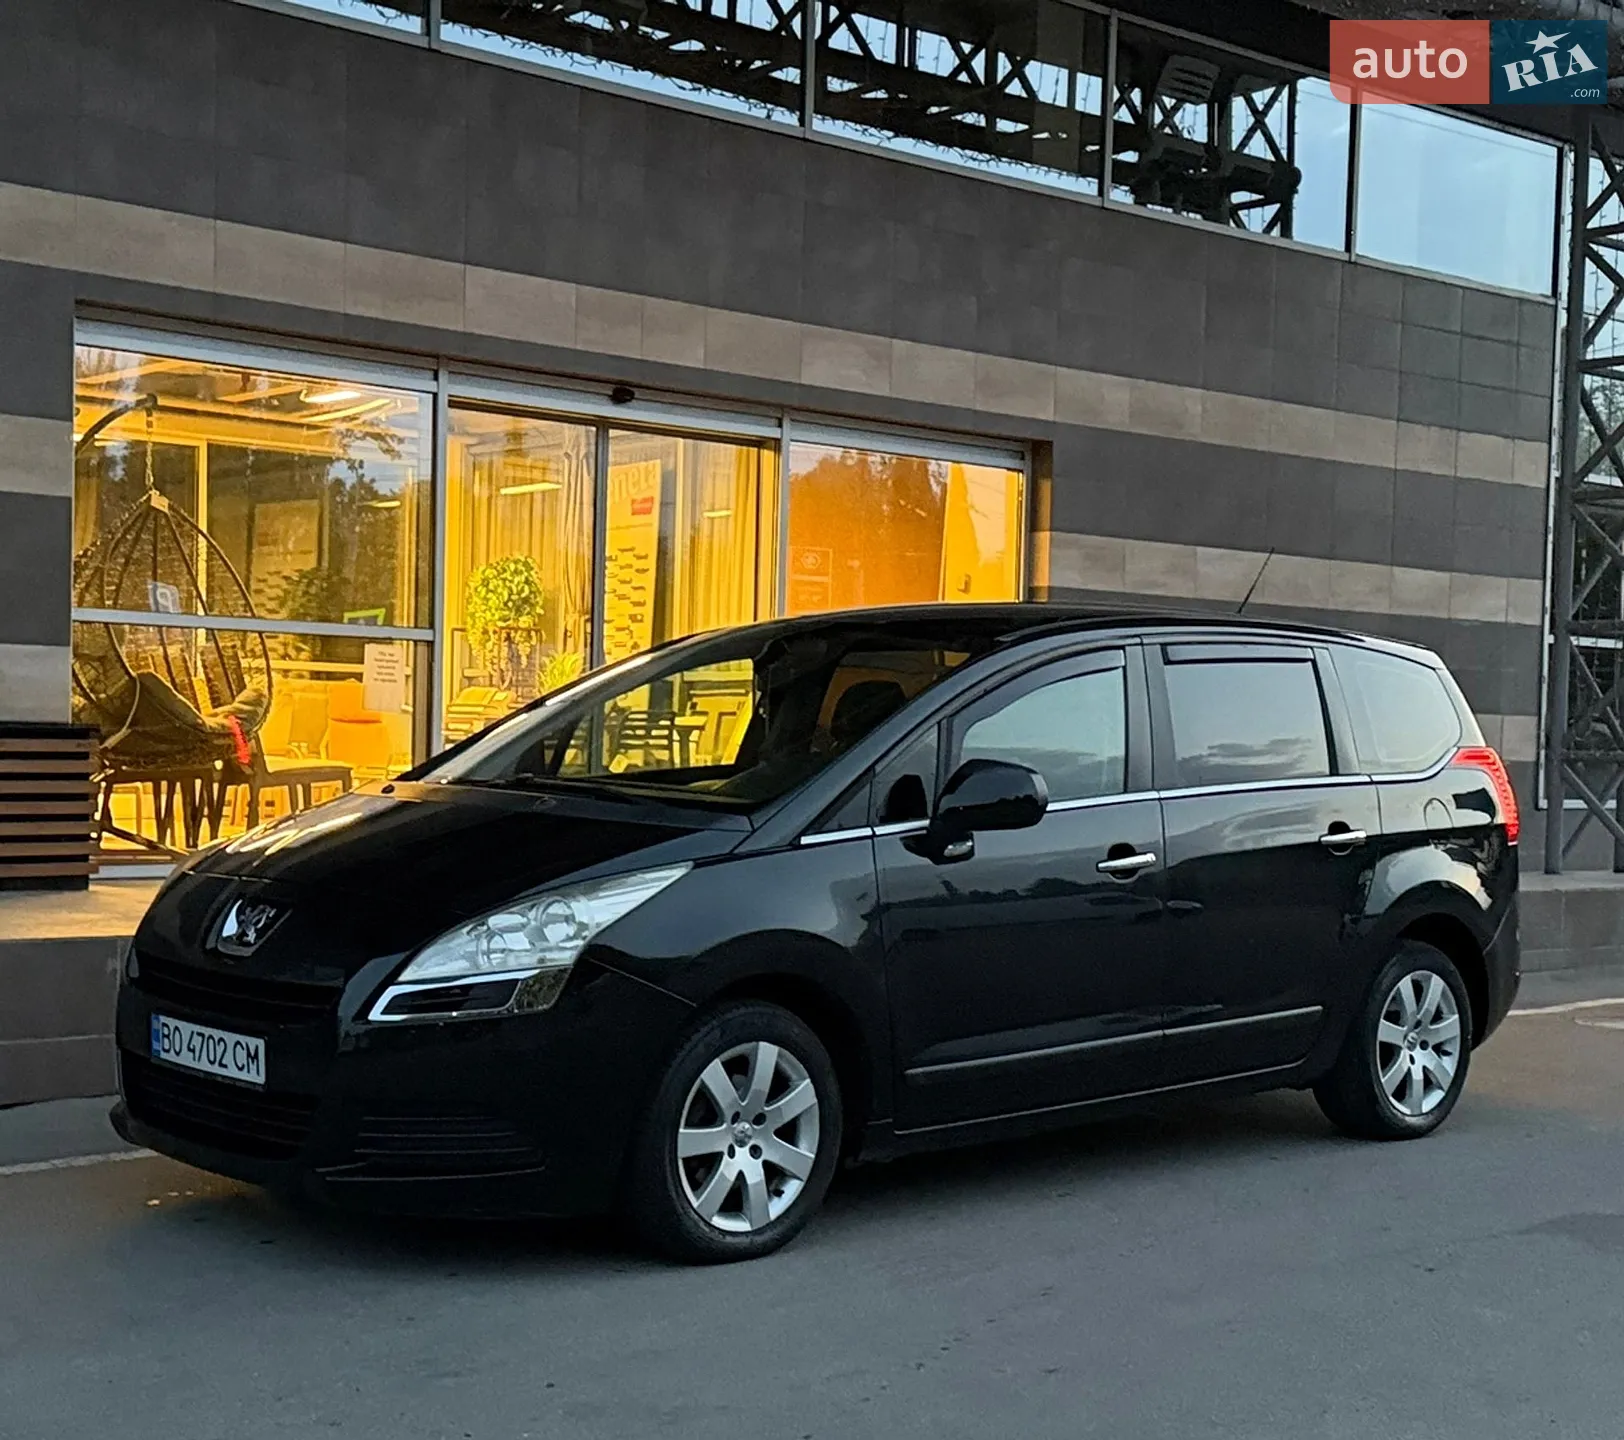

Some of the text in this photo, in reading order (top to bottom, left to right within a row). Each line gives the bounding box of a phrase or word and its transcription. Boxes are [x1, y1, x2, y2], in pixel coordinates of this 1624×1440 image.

[161, 1021, 260, 1077] BO 4702 CM
